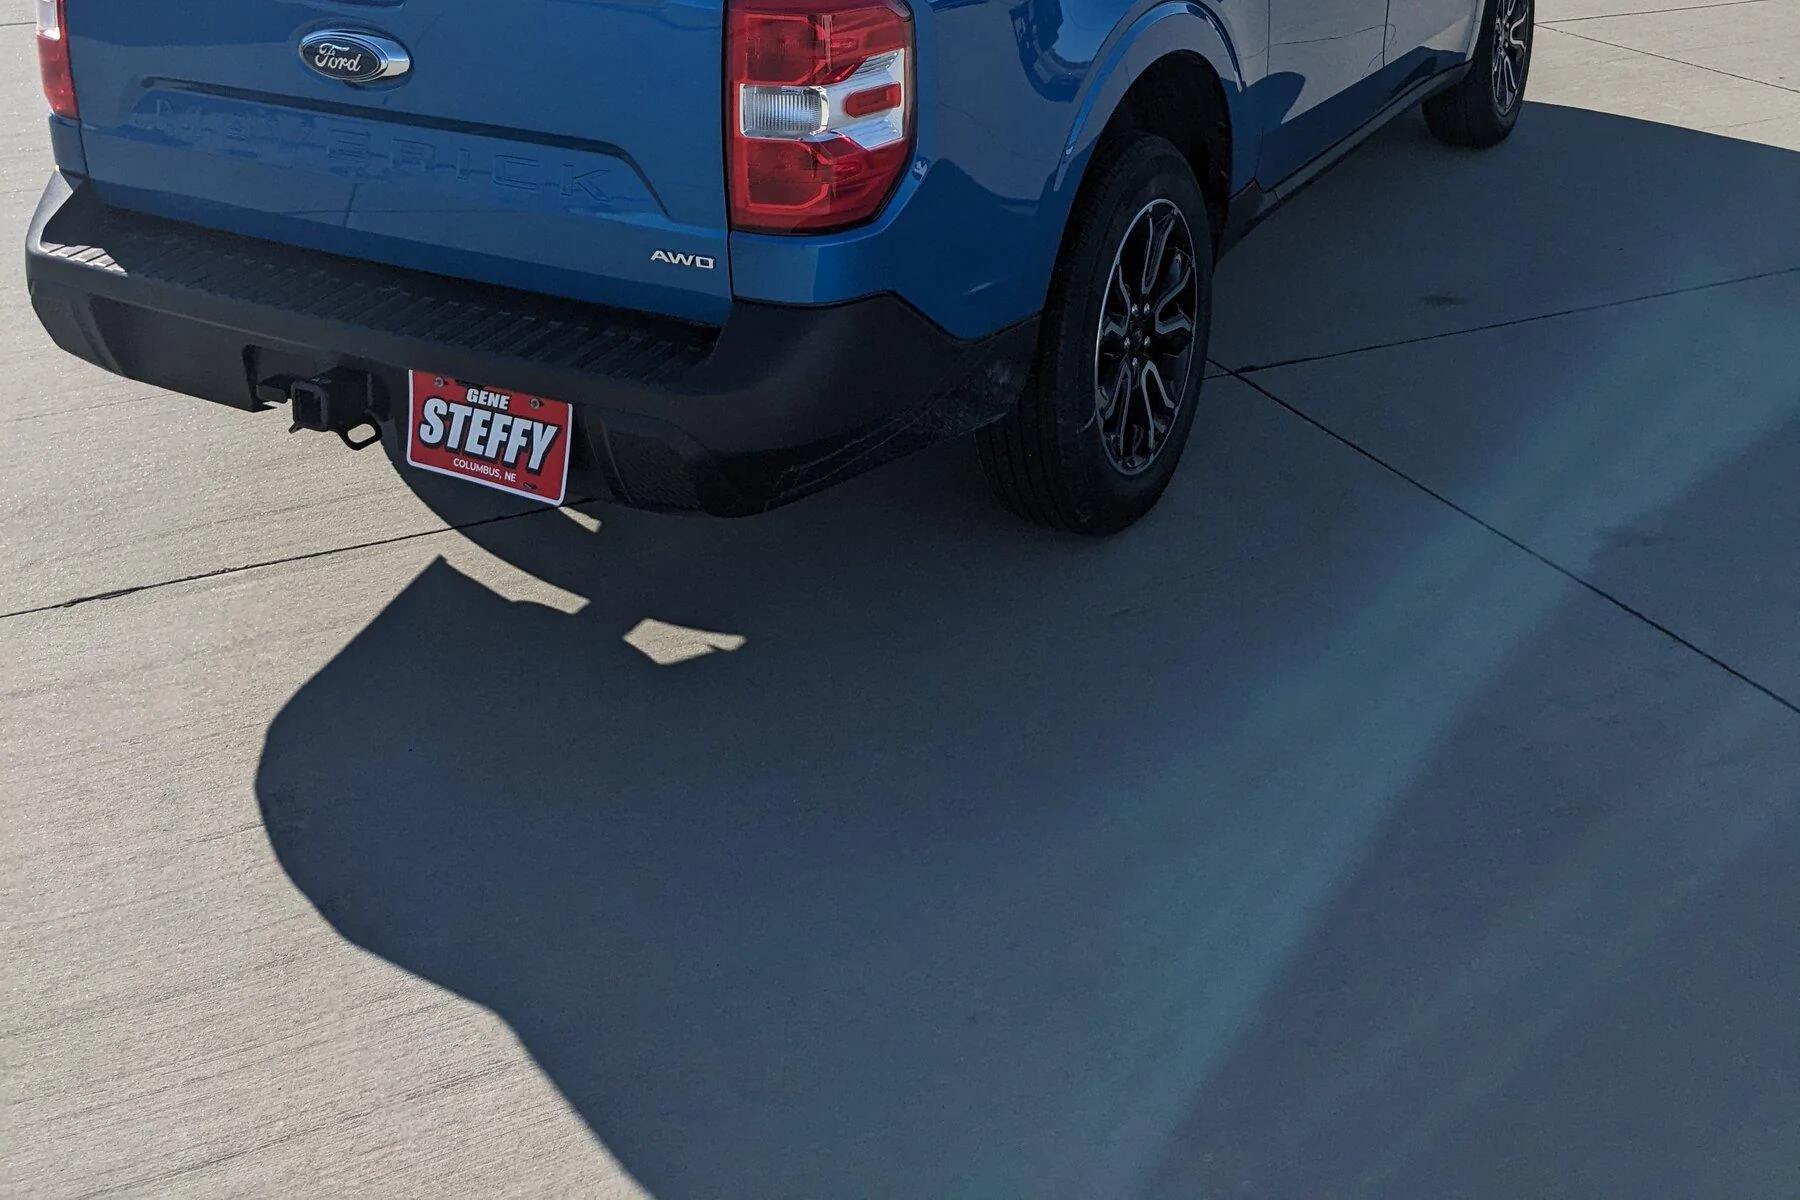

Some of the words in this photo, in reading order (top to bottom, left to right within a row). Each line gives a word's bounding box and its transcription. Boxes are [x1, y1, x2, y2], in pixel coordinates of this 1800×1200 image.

[315, 43, 361, 72] Ford
[650, 250, 715, 269] AWD
[466, 388, 510, 410] GENE
[419, 398, 558, 470] STEFFY
[453, 458, 502, 479] COLUMBUS,
[504, 472, 517, 483] NE
